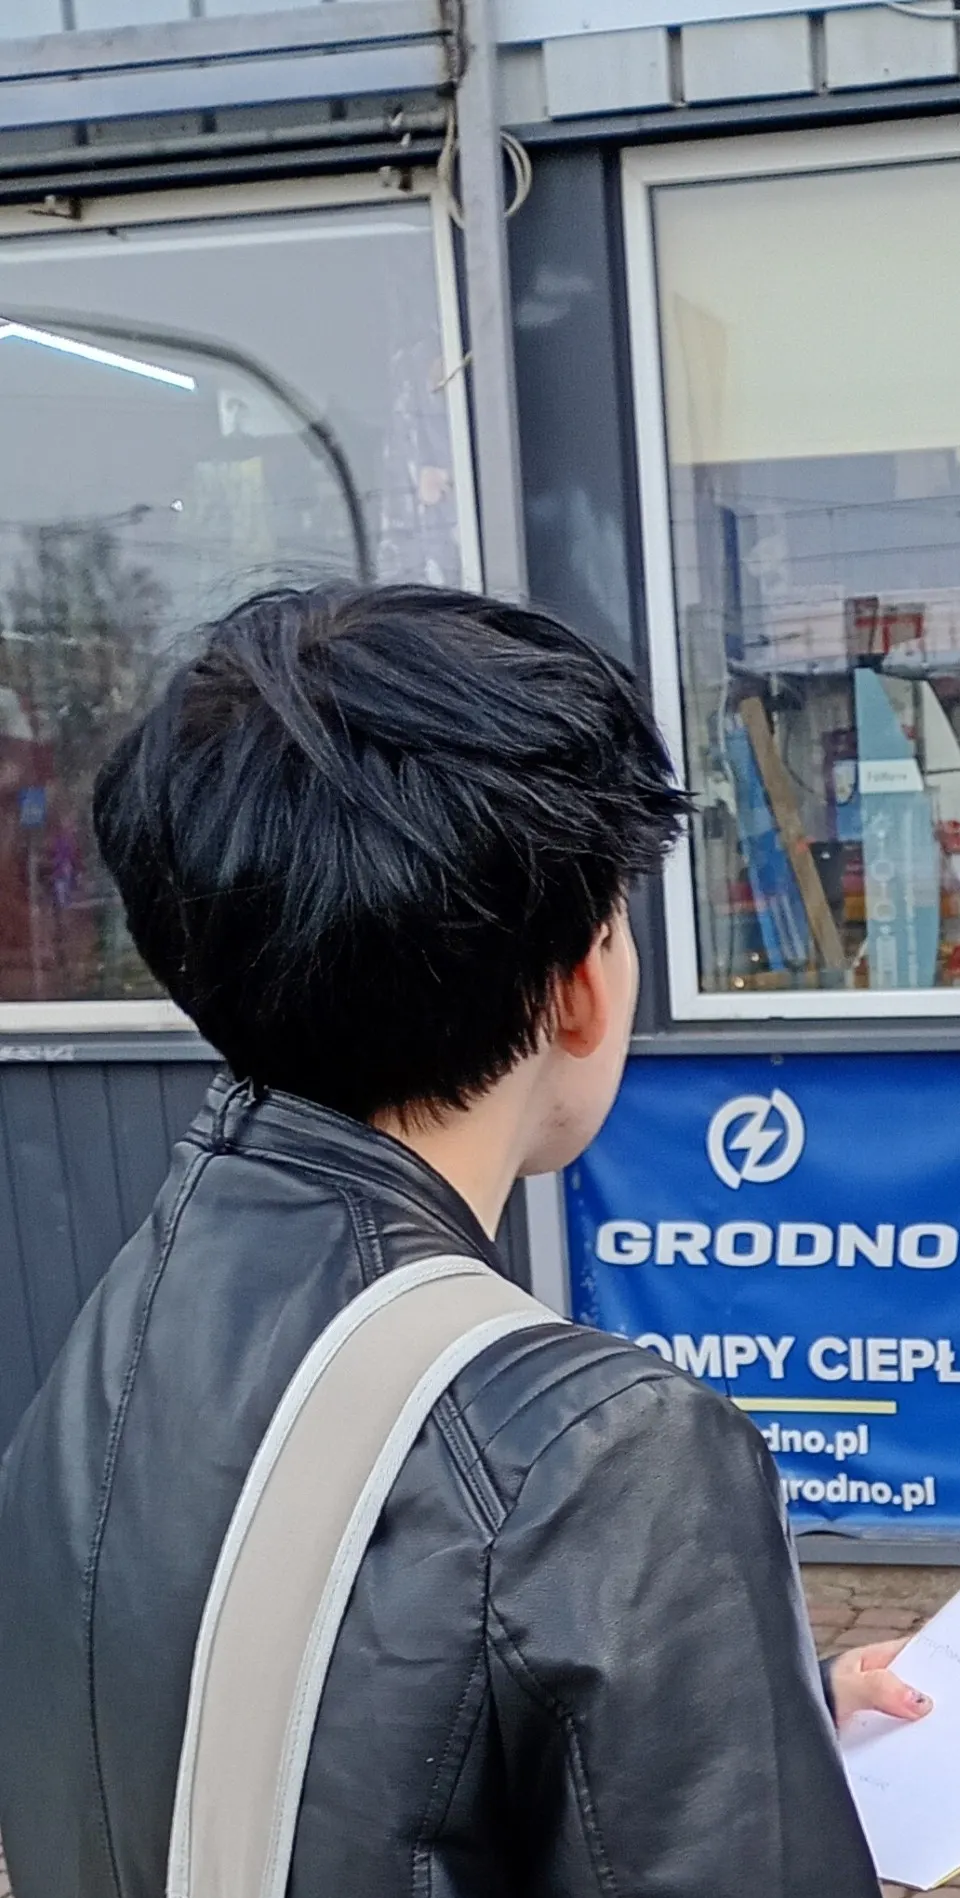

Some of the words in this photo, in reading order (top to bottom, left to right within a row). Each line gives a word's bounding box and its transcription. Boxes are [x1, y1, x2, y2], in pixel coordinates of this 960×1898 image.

[597, 1219, 958, 1269] GRODNO
[760, 1422, 868, 1461] dno.pl
[780, 1473, 936, 1512] rodno.pl
